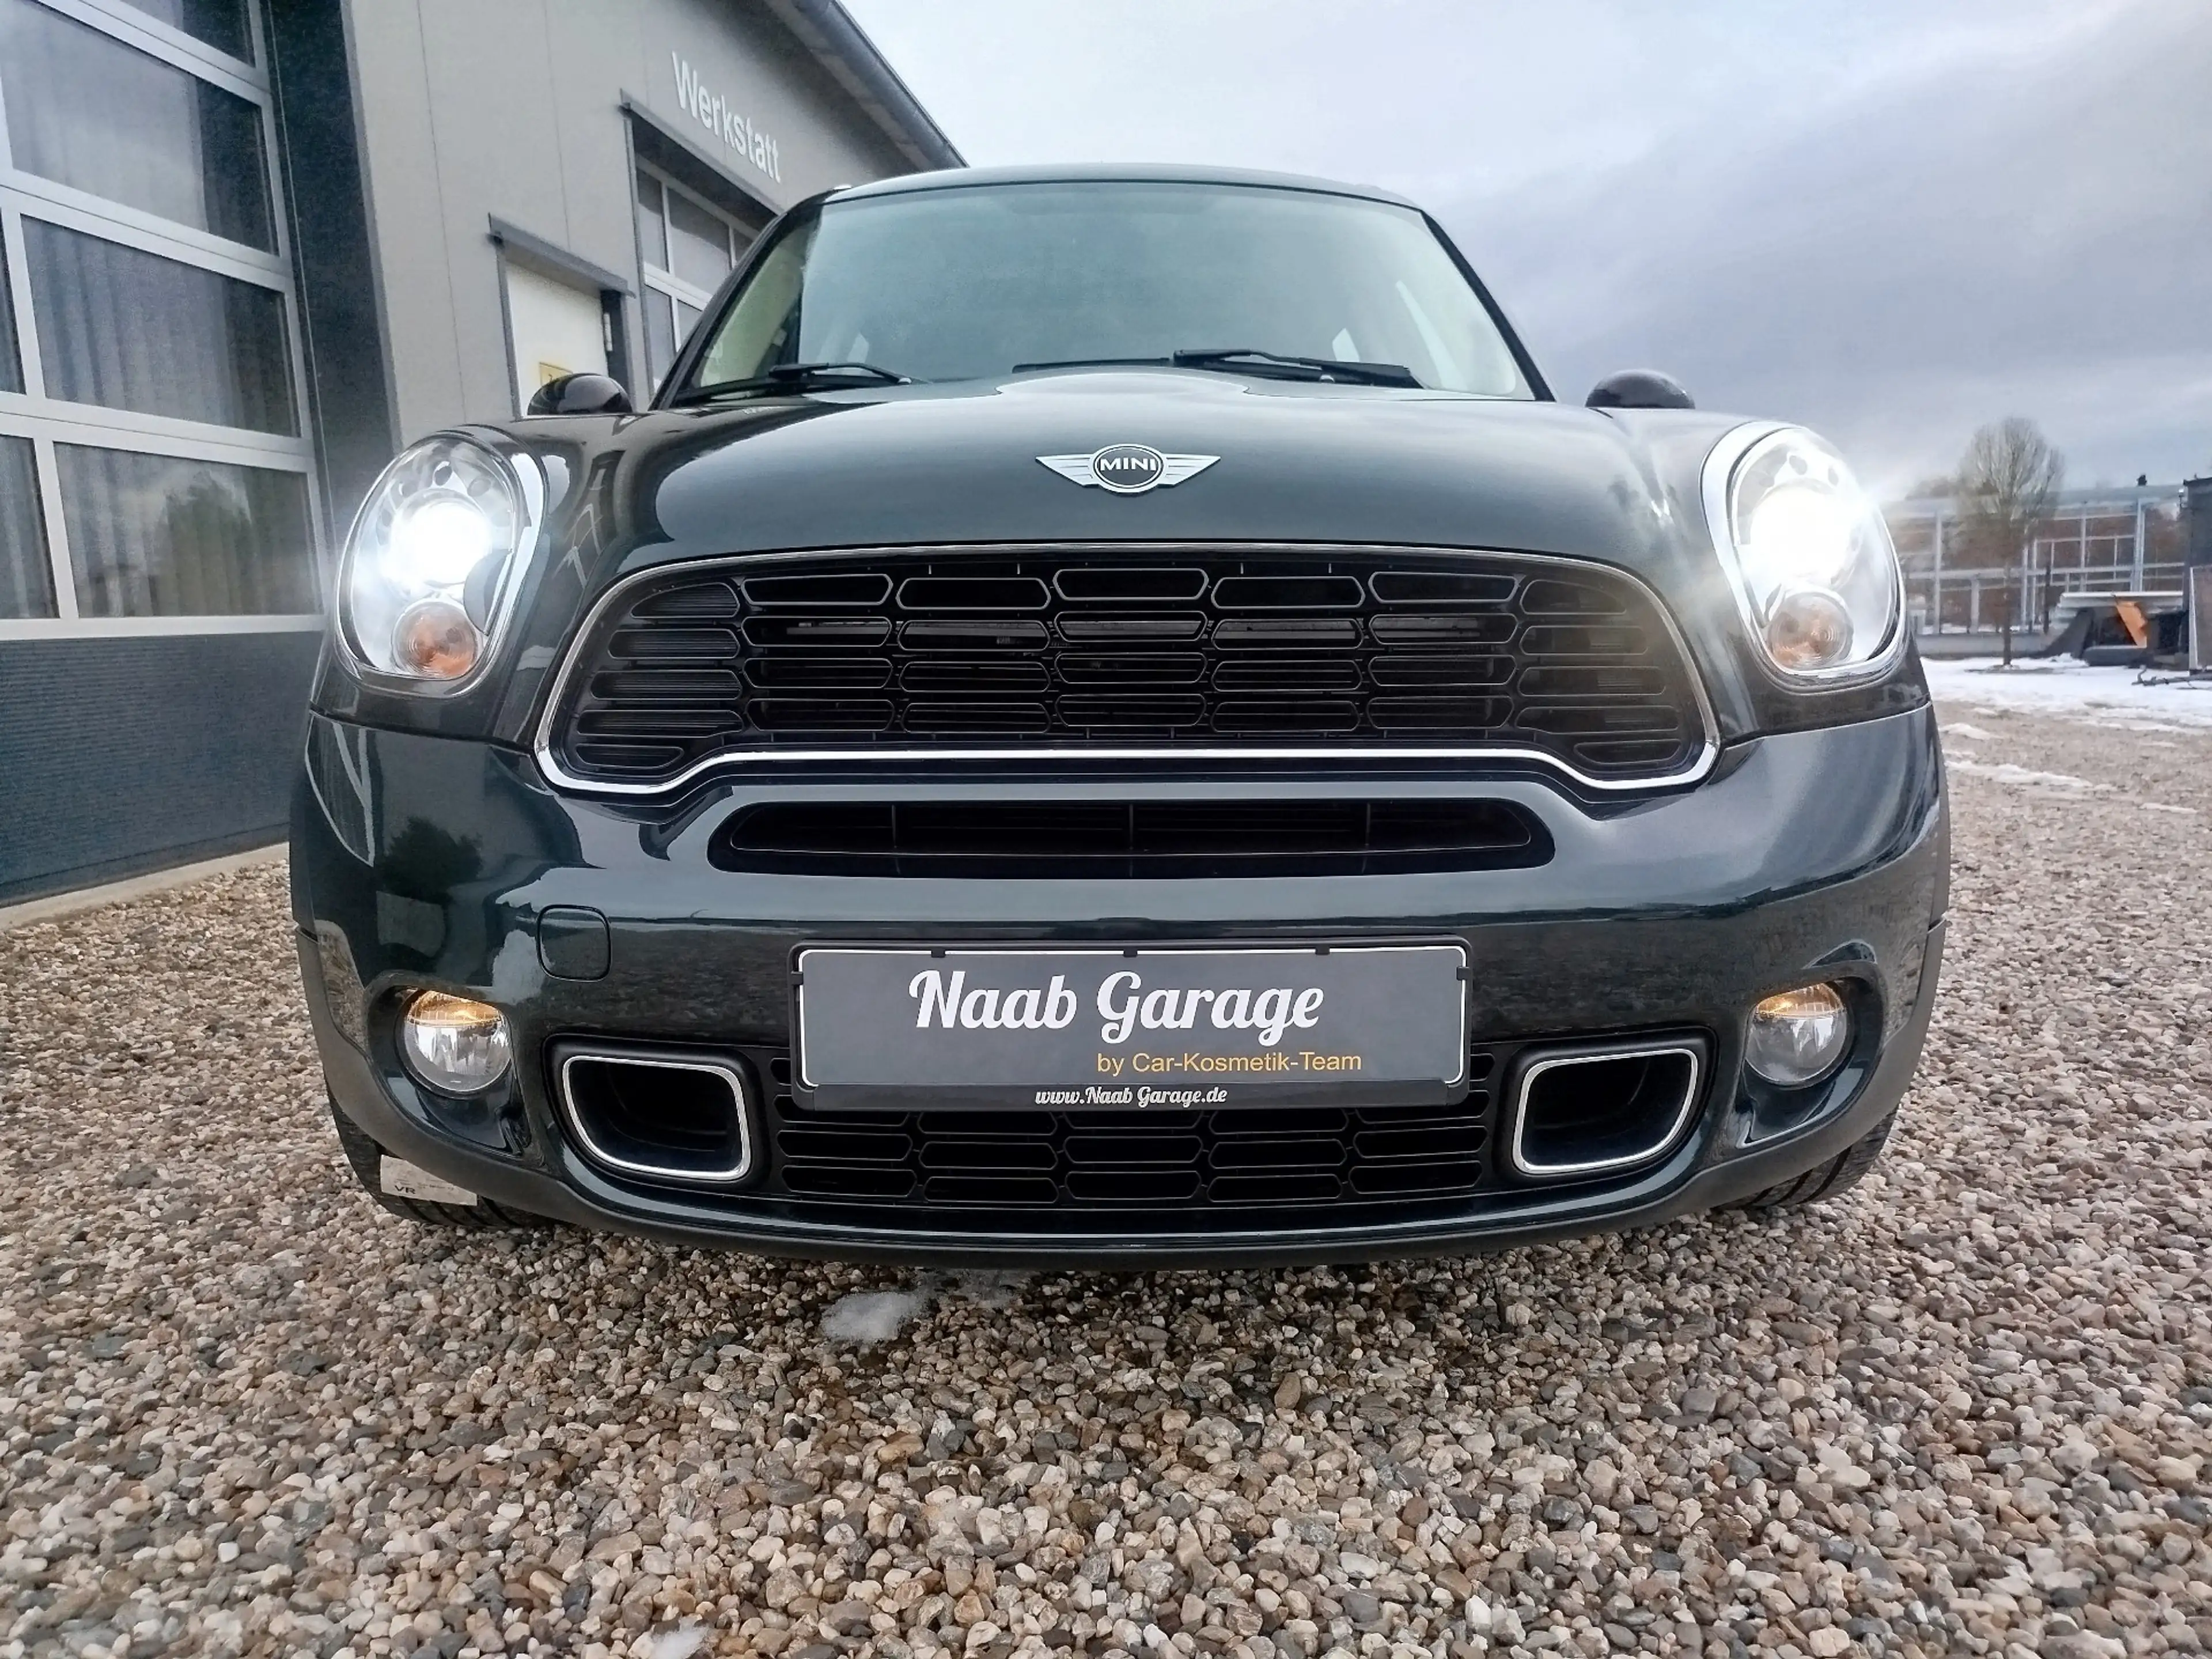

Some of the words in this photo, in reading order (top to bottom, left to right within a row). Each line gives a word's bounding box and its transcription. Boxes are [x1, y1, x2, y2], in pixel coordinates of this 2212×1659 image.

[672, 50, 781, 184] Werkstatt
[1100, 457, 1157, 471] MINI
[908, 970, 1077, 1029] Naab
[1096, 970, 1325, 1046] Garage
[1097, 1053, 1124, 1076] by
[1132, 1051, 1362, 1073] Car-Kosmetik-Team
